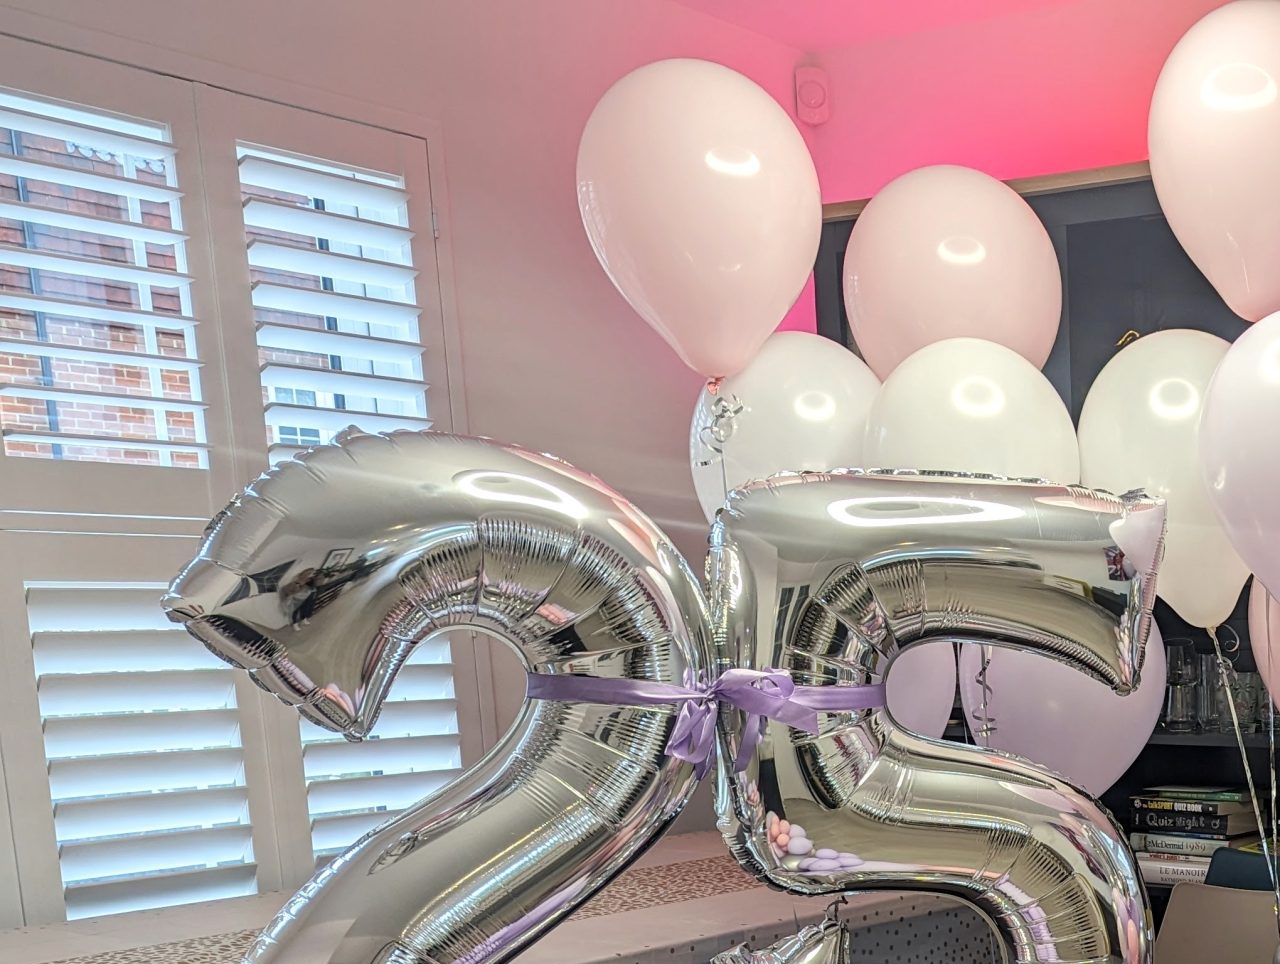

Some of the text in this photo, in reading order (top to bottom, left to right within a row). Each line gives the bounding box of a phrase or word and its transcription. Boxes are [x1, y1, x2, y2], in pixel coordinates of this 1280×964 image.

[1174, 802, 1187, 812] QUIZ
[1187, 804, 1203, 813] BOOK
[1146, 812, 1175, 827] Quiz
[1171, 868, 1207, 878] MANOIR
